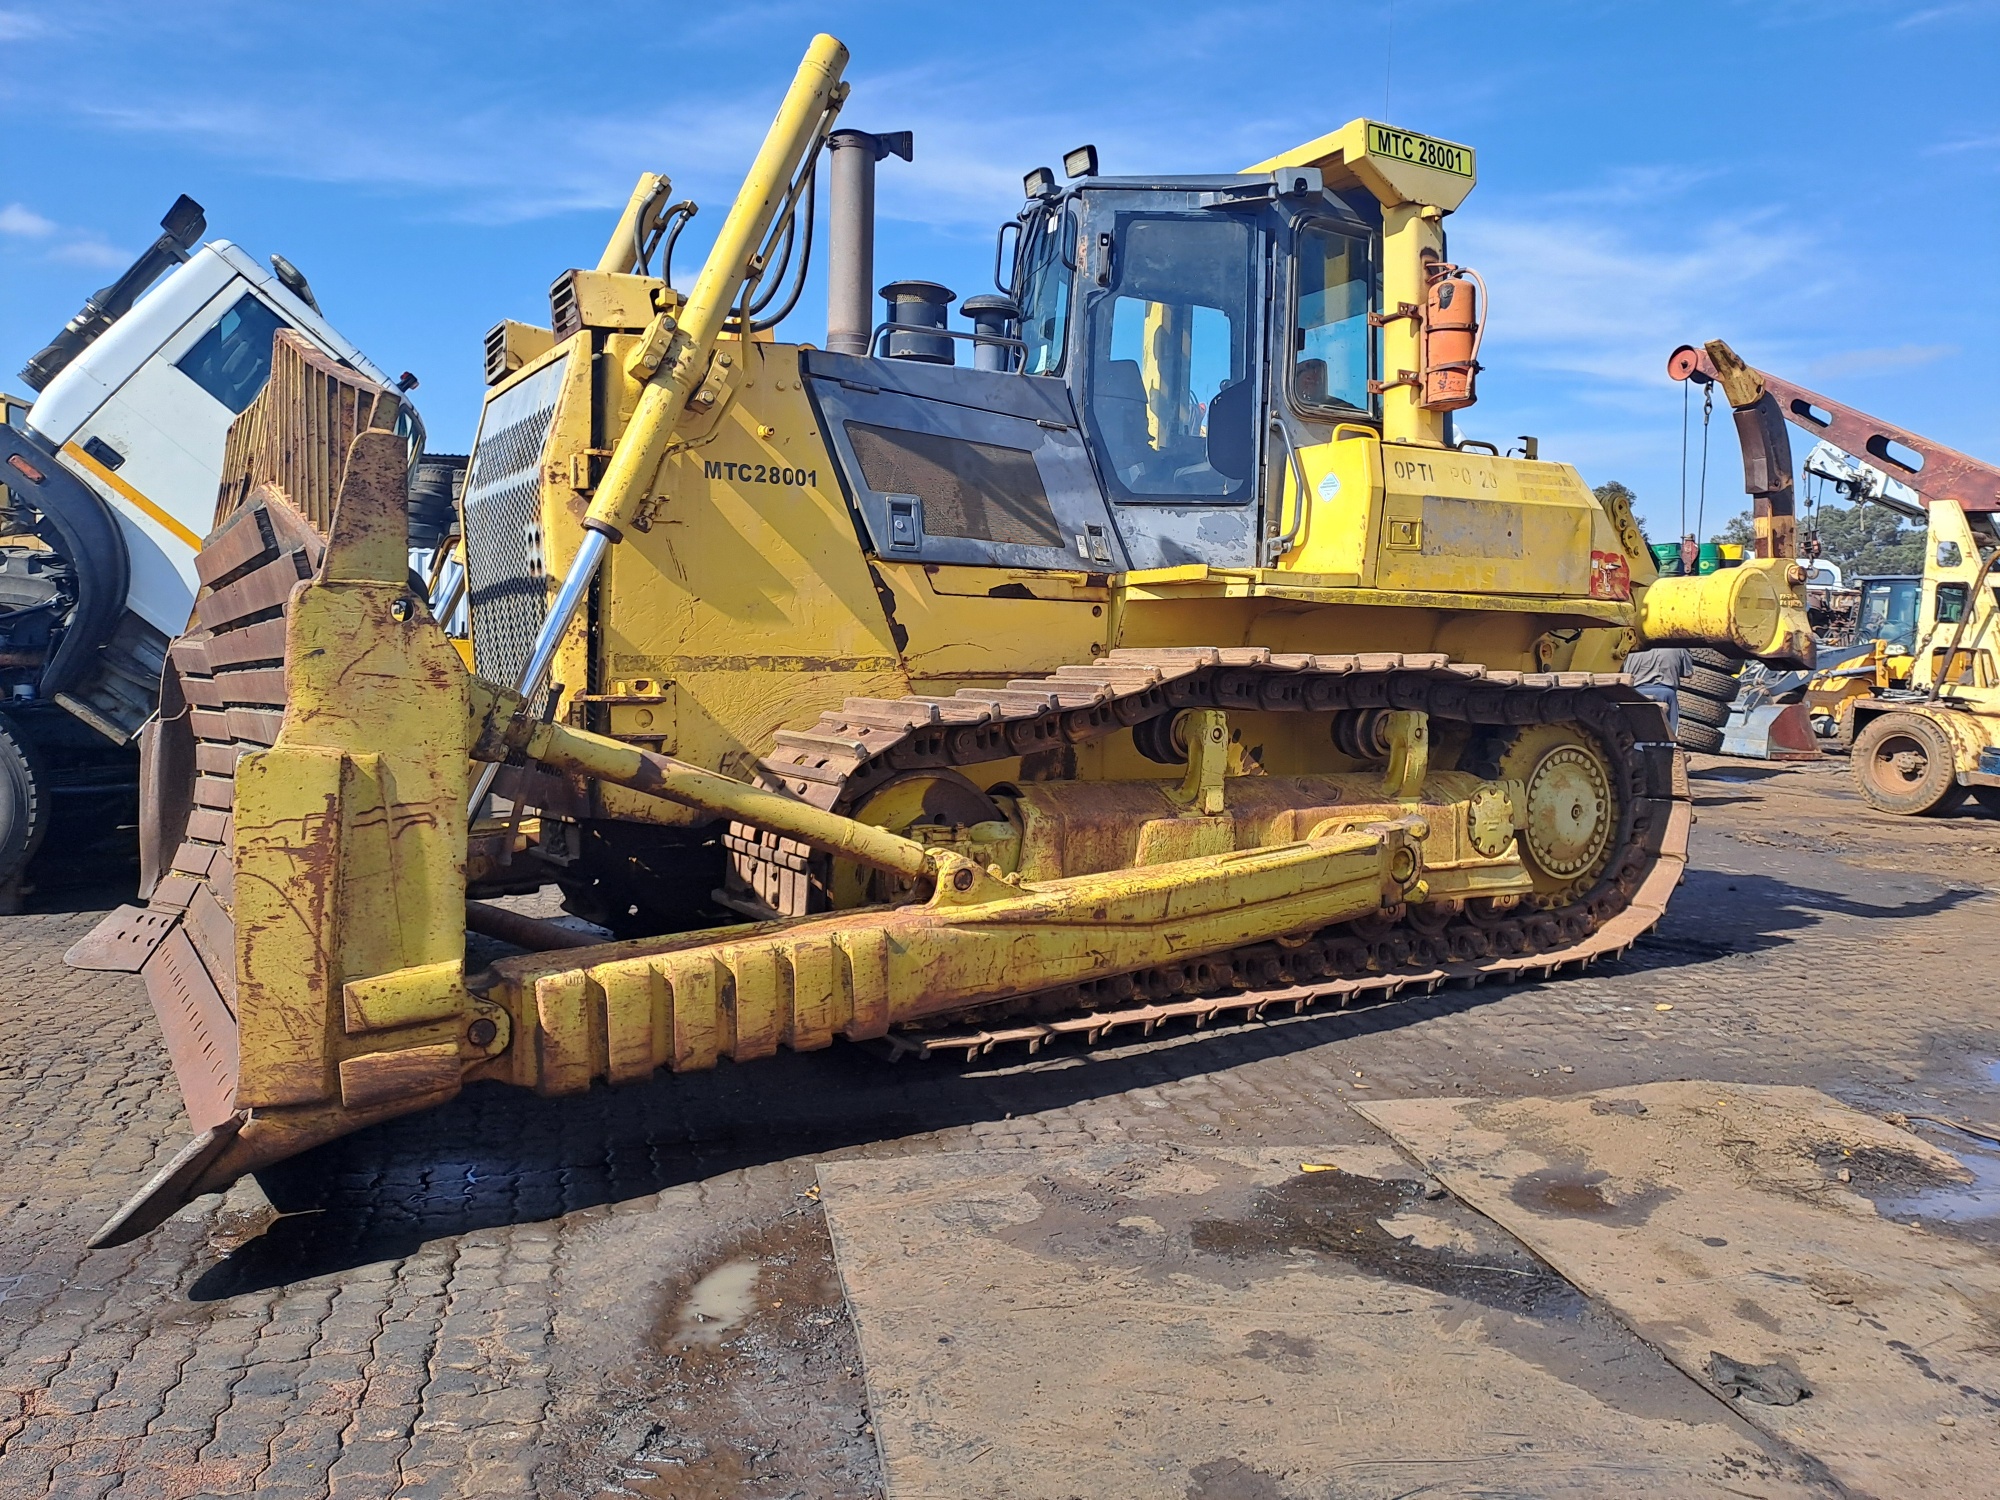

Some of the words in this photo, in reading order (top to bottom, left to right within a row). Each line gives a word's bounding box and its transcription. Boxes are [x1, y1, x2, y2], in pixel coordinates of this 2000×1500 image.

[1378, 129, 1413, 159] MTC
[1418, 141, 1462, 171] 28001
[704, 460, 817, 487] MTC28001
[1394, 461, 1434, 482] OPTI
